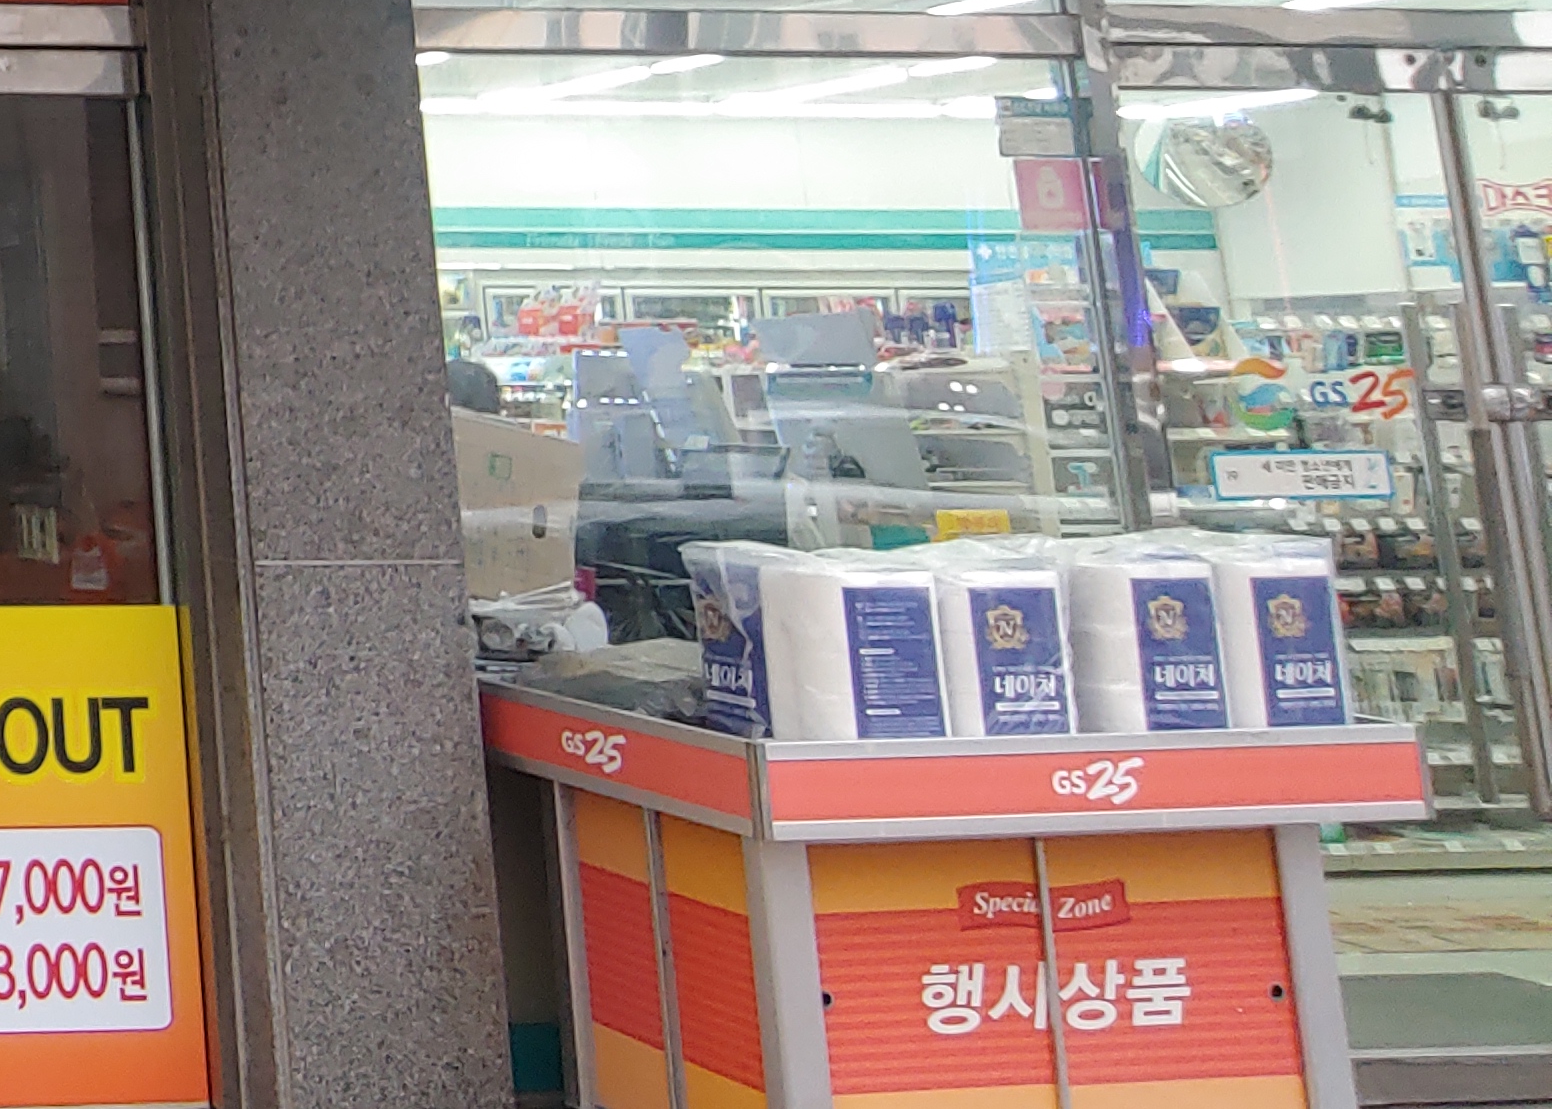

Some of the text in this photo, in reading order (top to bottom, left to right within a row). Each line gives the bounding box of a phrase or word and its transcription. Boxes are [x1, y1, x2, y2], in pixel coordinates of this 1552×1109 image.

[994, 674, 1057, 698] 네이처
[1154, 663, 1215, 687] 네이처
[1274, 660, 1333, 686] 네이처
[561, 729, 627, 774] GS25
[1051, 756, 1145, 805] GS25
[973, 891, 1043, 919] Specia
[921, 958, 1192, 1035] 행사상품
